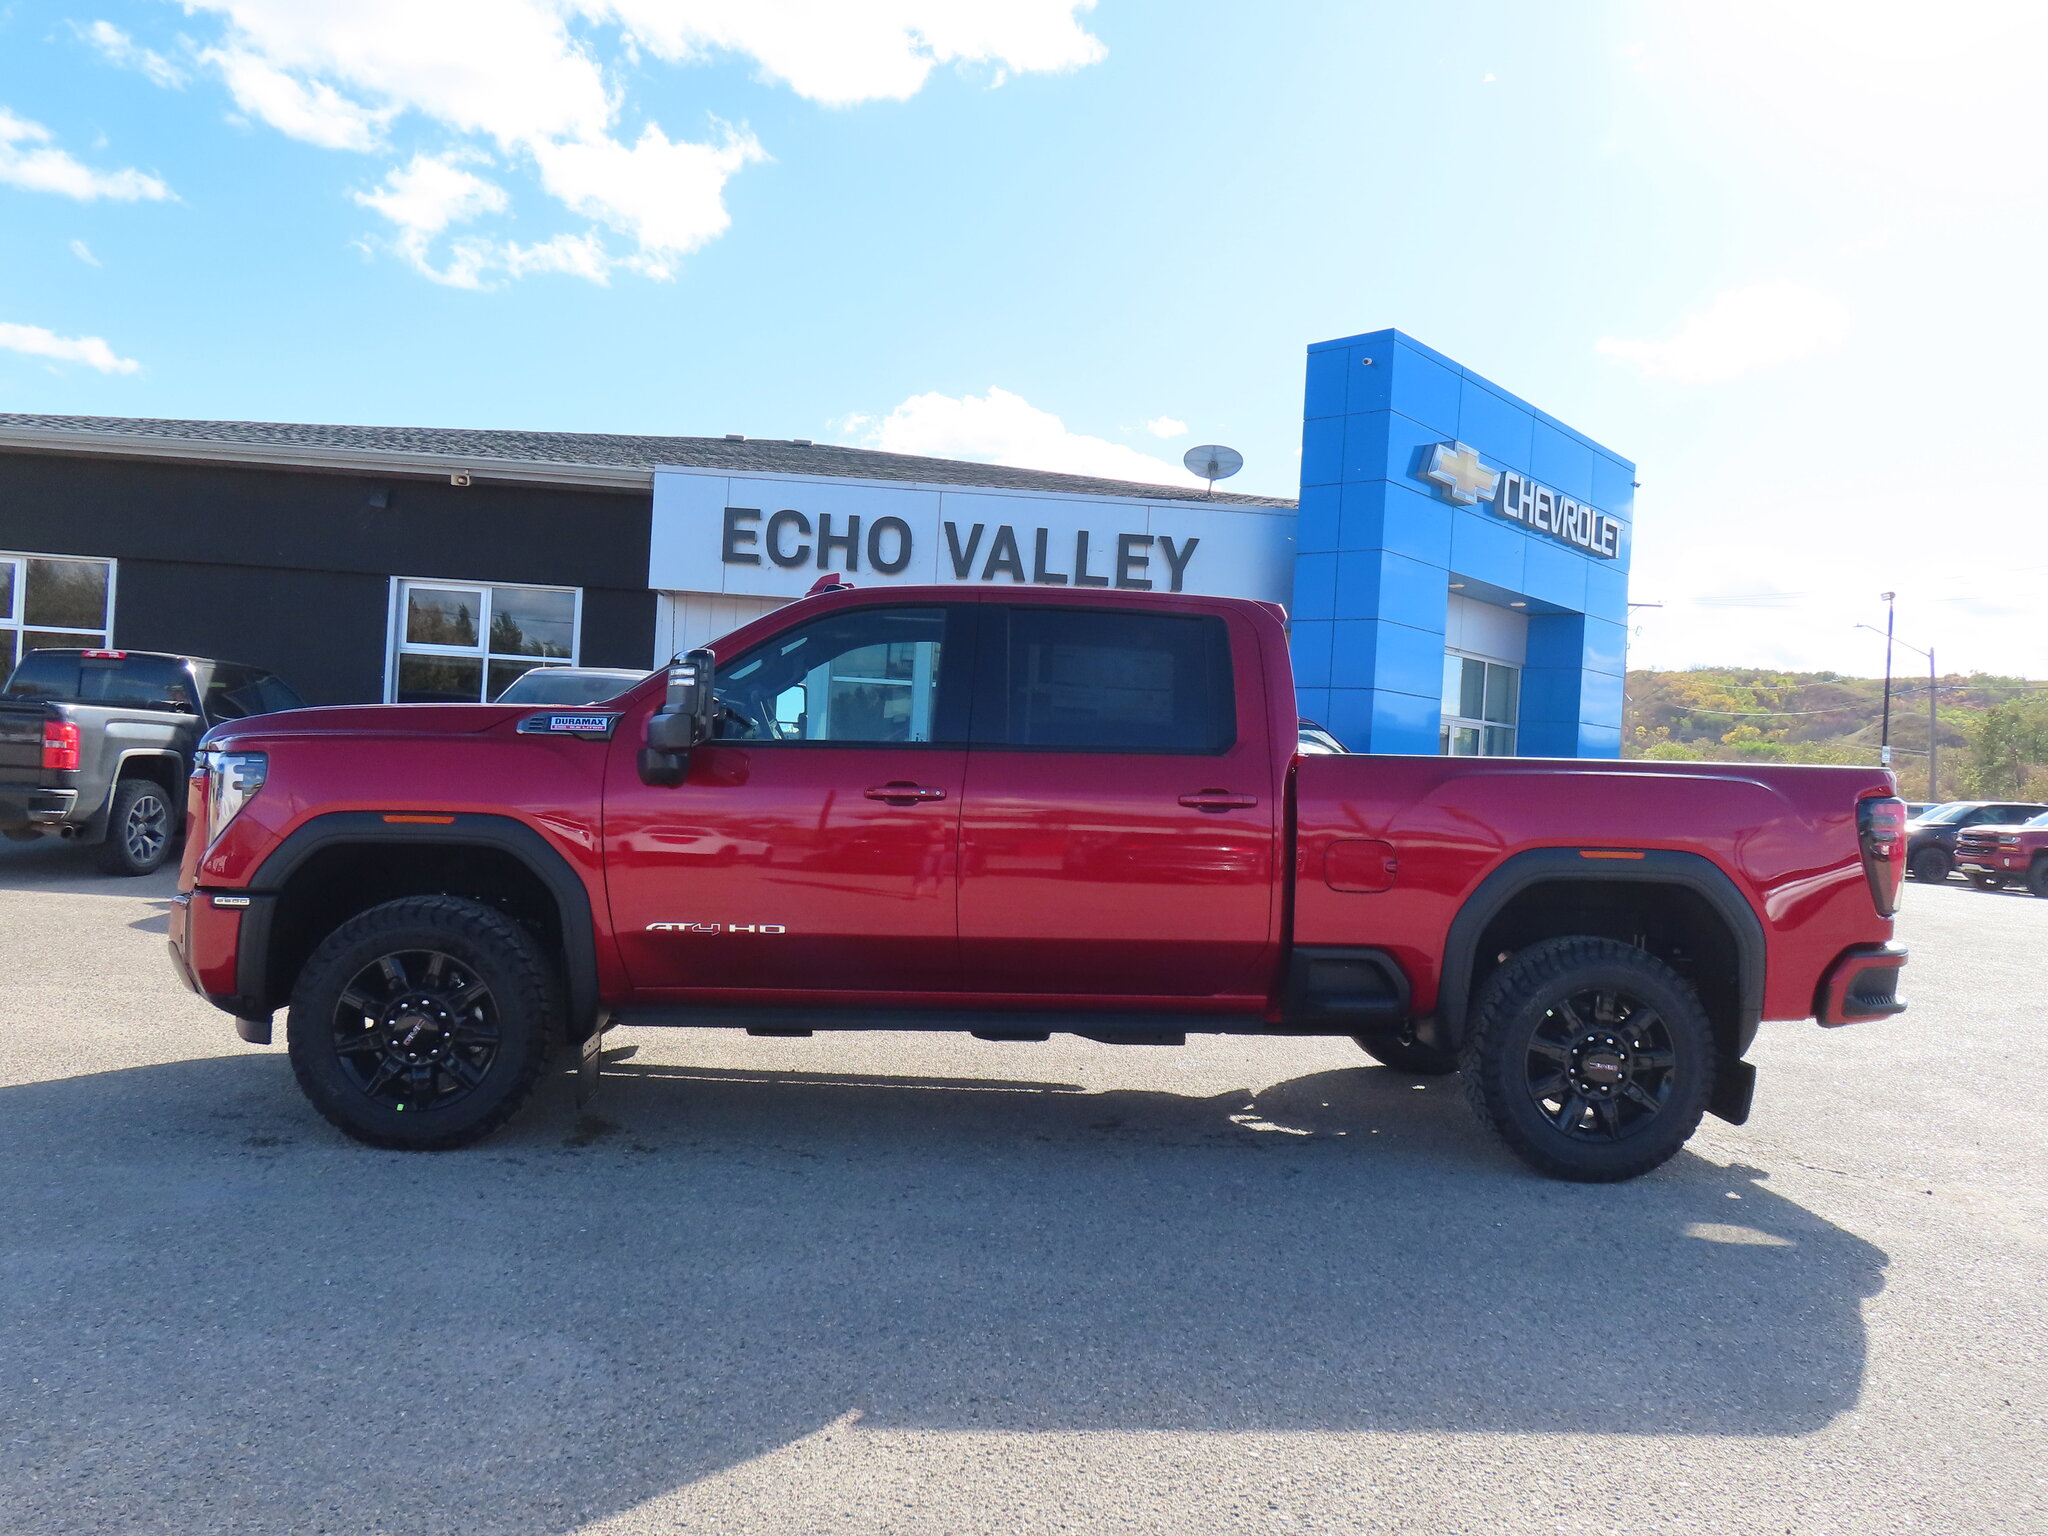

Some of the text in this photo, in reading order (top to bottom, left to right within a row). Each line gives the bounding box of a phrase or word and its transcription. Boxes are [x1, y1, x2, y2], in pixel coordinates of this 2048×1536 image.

[1503, 471, 1624, 559] CHEVROLET
[722, 506, 1199, 591] ECHO VALLEY
[555, 717, 604, 726] DURAMAX
[646, 922, 786, 936] AT4 HD
